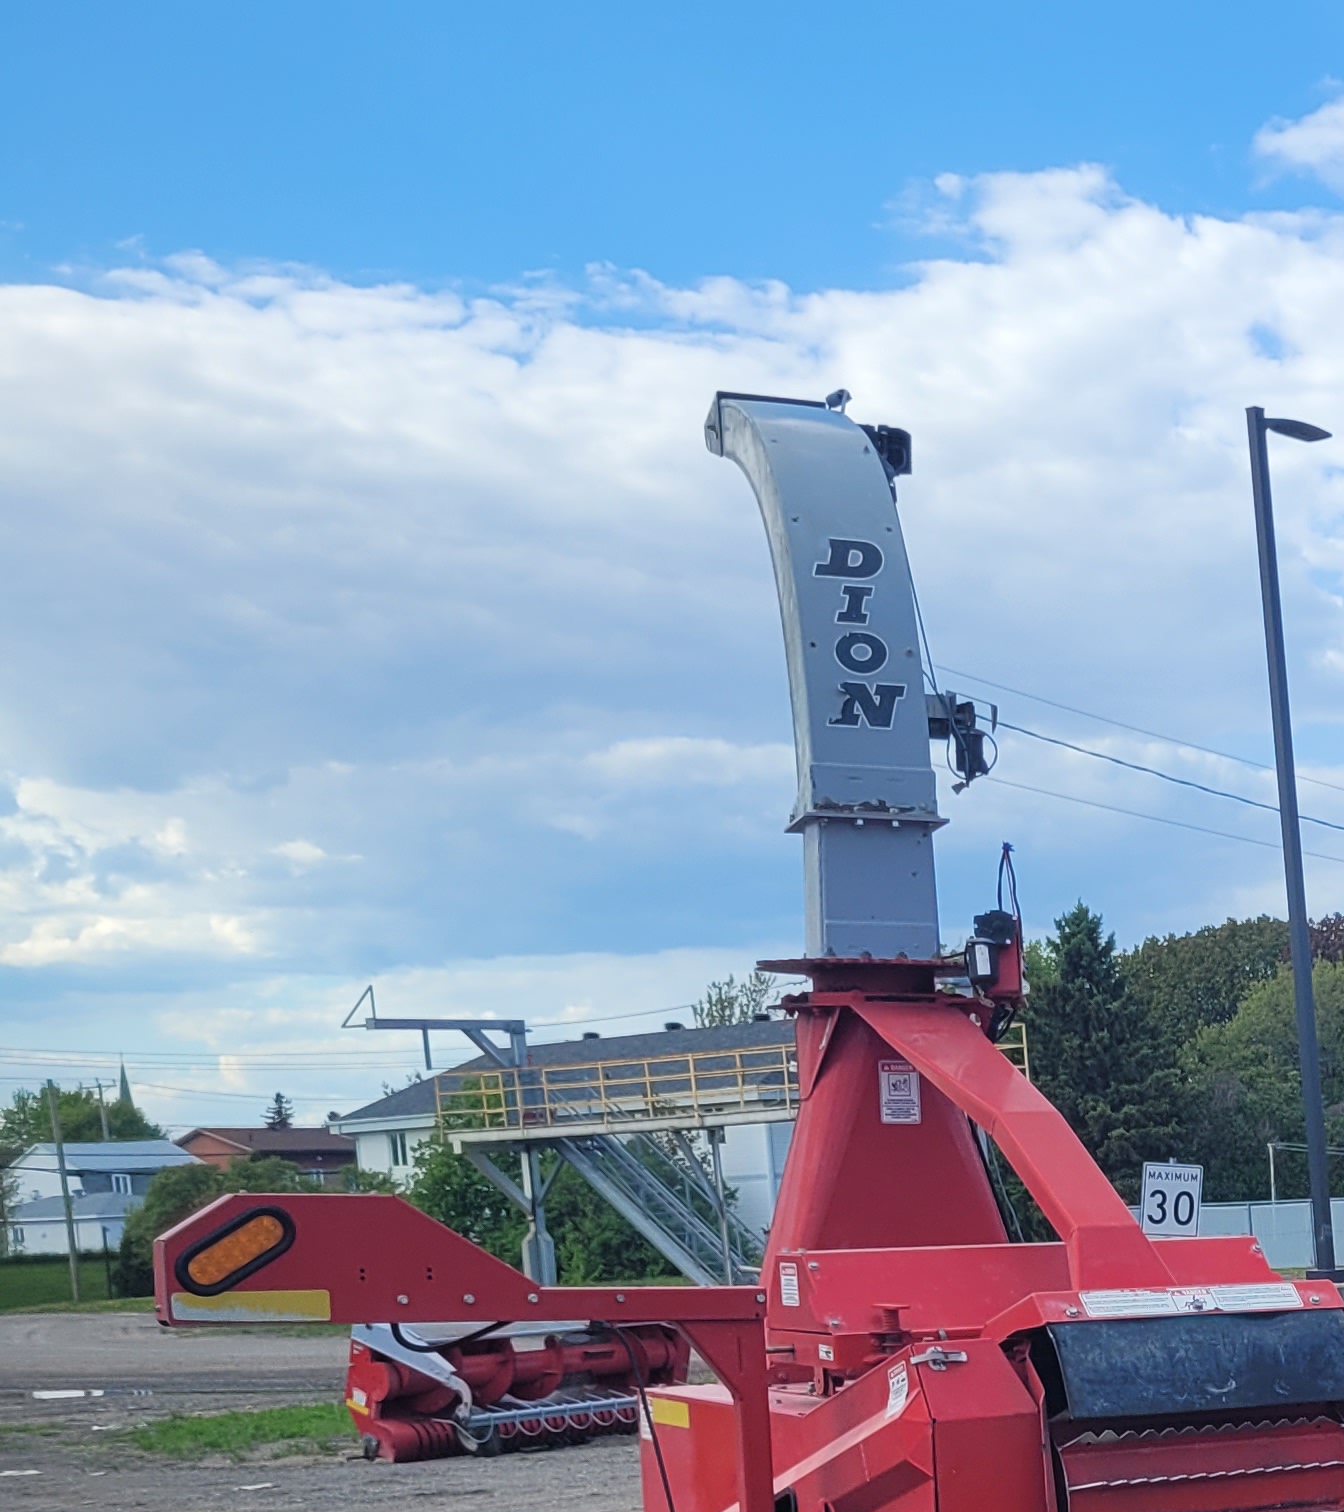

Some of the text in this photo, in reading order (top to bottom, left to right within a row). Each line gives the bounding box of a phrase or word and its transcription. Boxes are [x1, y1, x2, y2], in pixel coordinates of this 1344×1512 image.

[812, 537, 906, 730] DION
[1148, 1170, 1198, 1182] MAXIMUM
[1147, 1190, 1194, 1226] 30
